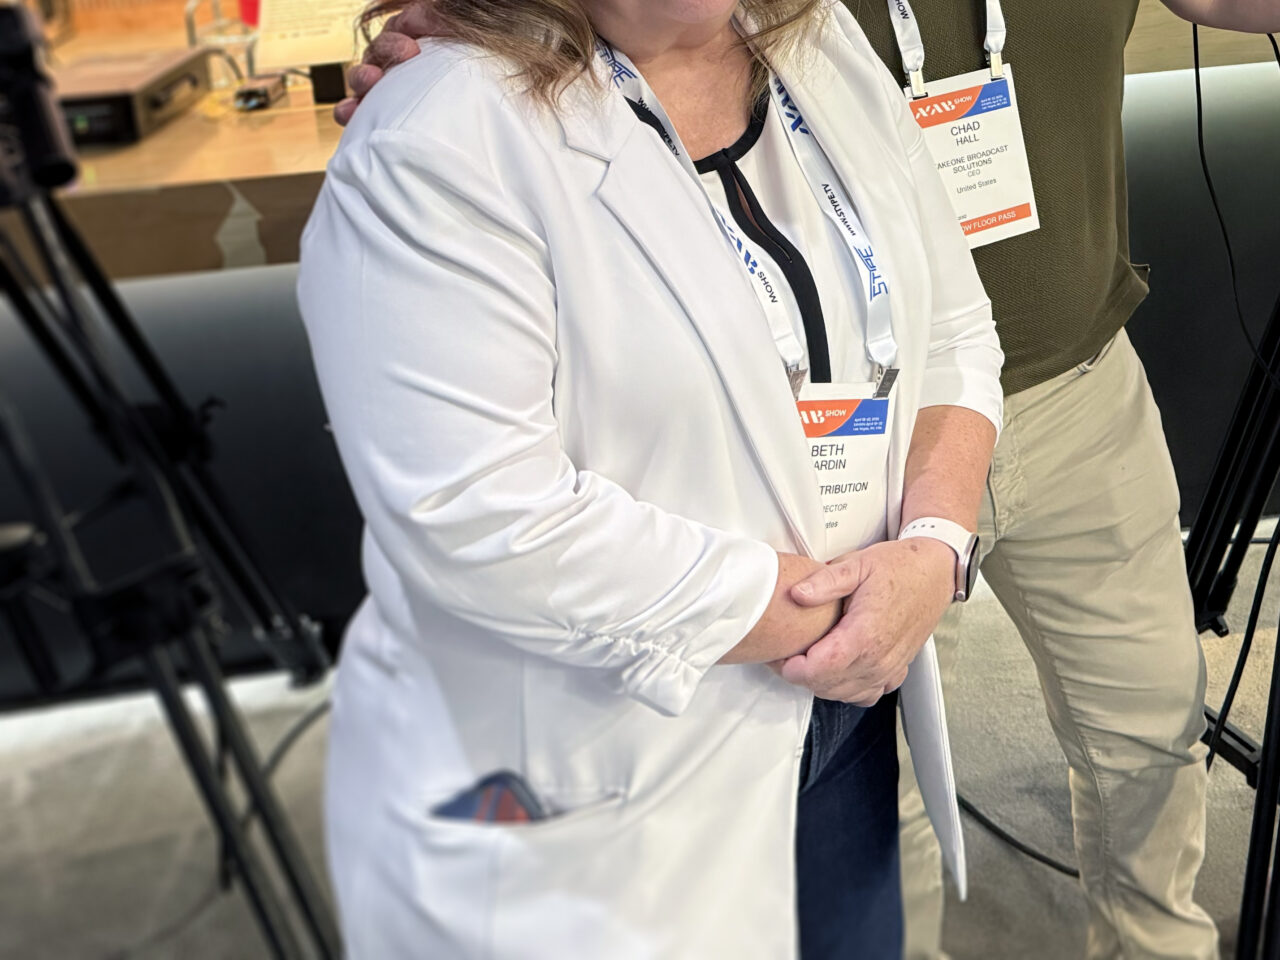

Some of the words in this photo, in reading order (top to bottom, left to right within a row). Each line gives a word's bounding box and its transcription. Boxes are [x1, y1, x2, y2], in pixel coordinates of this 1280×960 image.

[954, 95, 973, 105] SHOW
[951, 121, 981, 136] CHAD
[956, 134, 980, 147] HALL
[936, 157, 966, 170] AKEONE
[967, 145, 1009, 162] BROADCAST
[953, 158, 993, 174] SOLUTIONS
[967, 169, 981, 178] CEO
[956, 183, 977, 194] United
[978, 178, 997, 188] States
[821, 183, 857, 236] WWW.STYPE.TV
[961, 224, 972, 232] OW
[973, 217, 997, 230] FLOOR
[998, 211, 1016, 222] PASS
[757, 271, 778, 304] SHOW
[800, 410, 825, 424] AB
[825, 409, 847, 417] SHOW
[811, 444, 845, 457] BETH
[814, 459, 847, 471] ARDIN
[819, 482, 868, 496] TRIBUTION
[822, 503, 848, 513] ECTOR
[825, 520, 839, 529] ates
